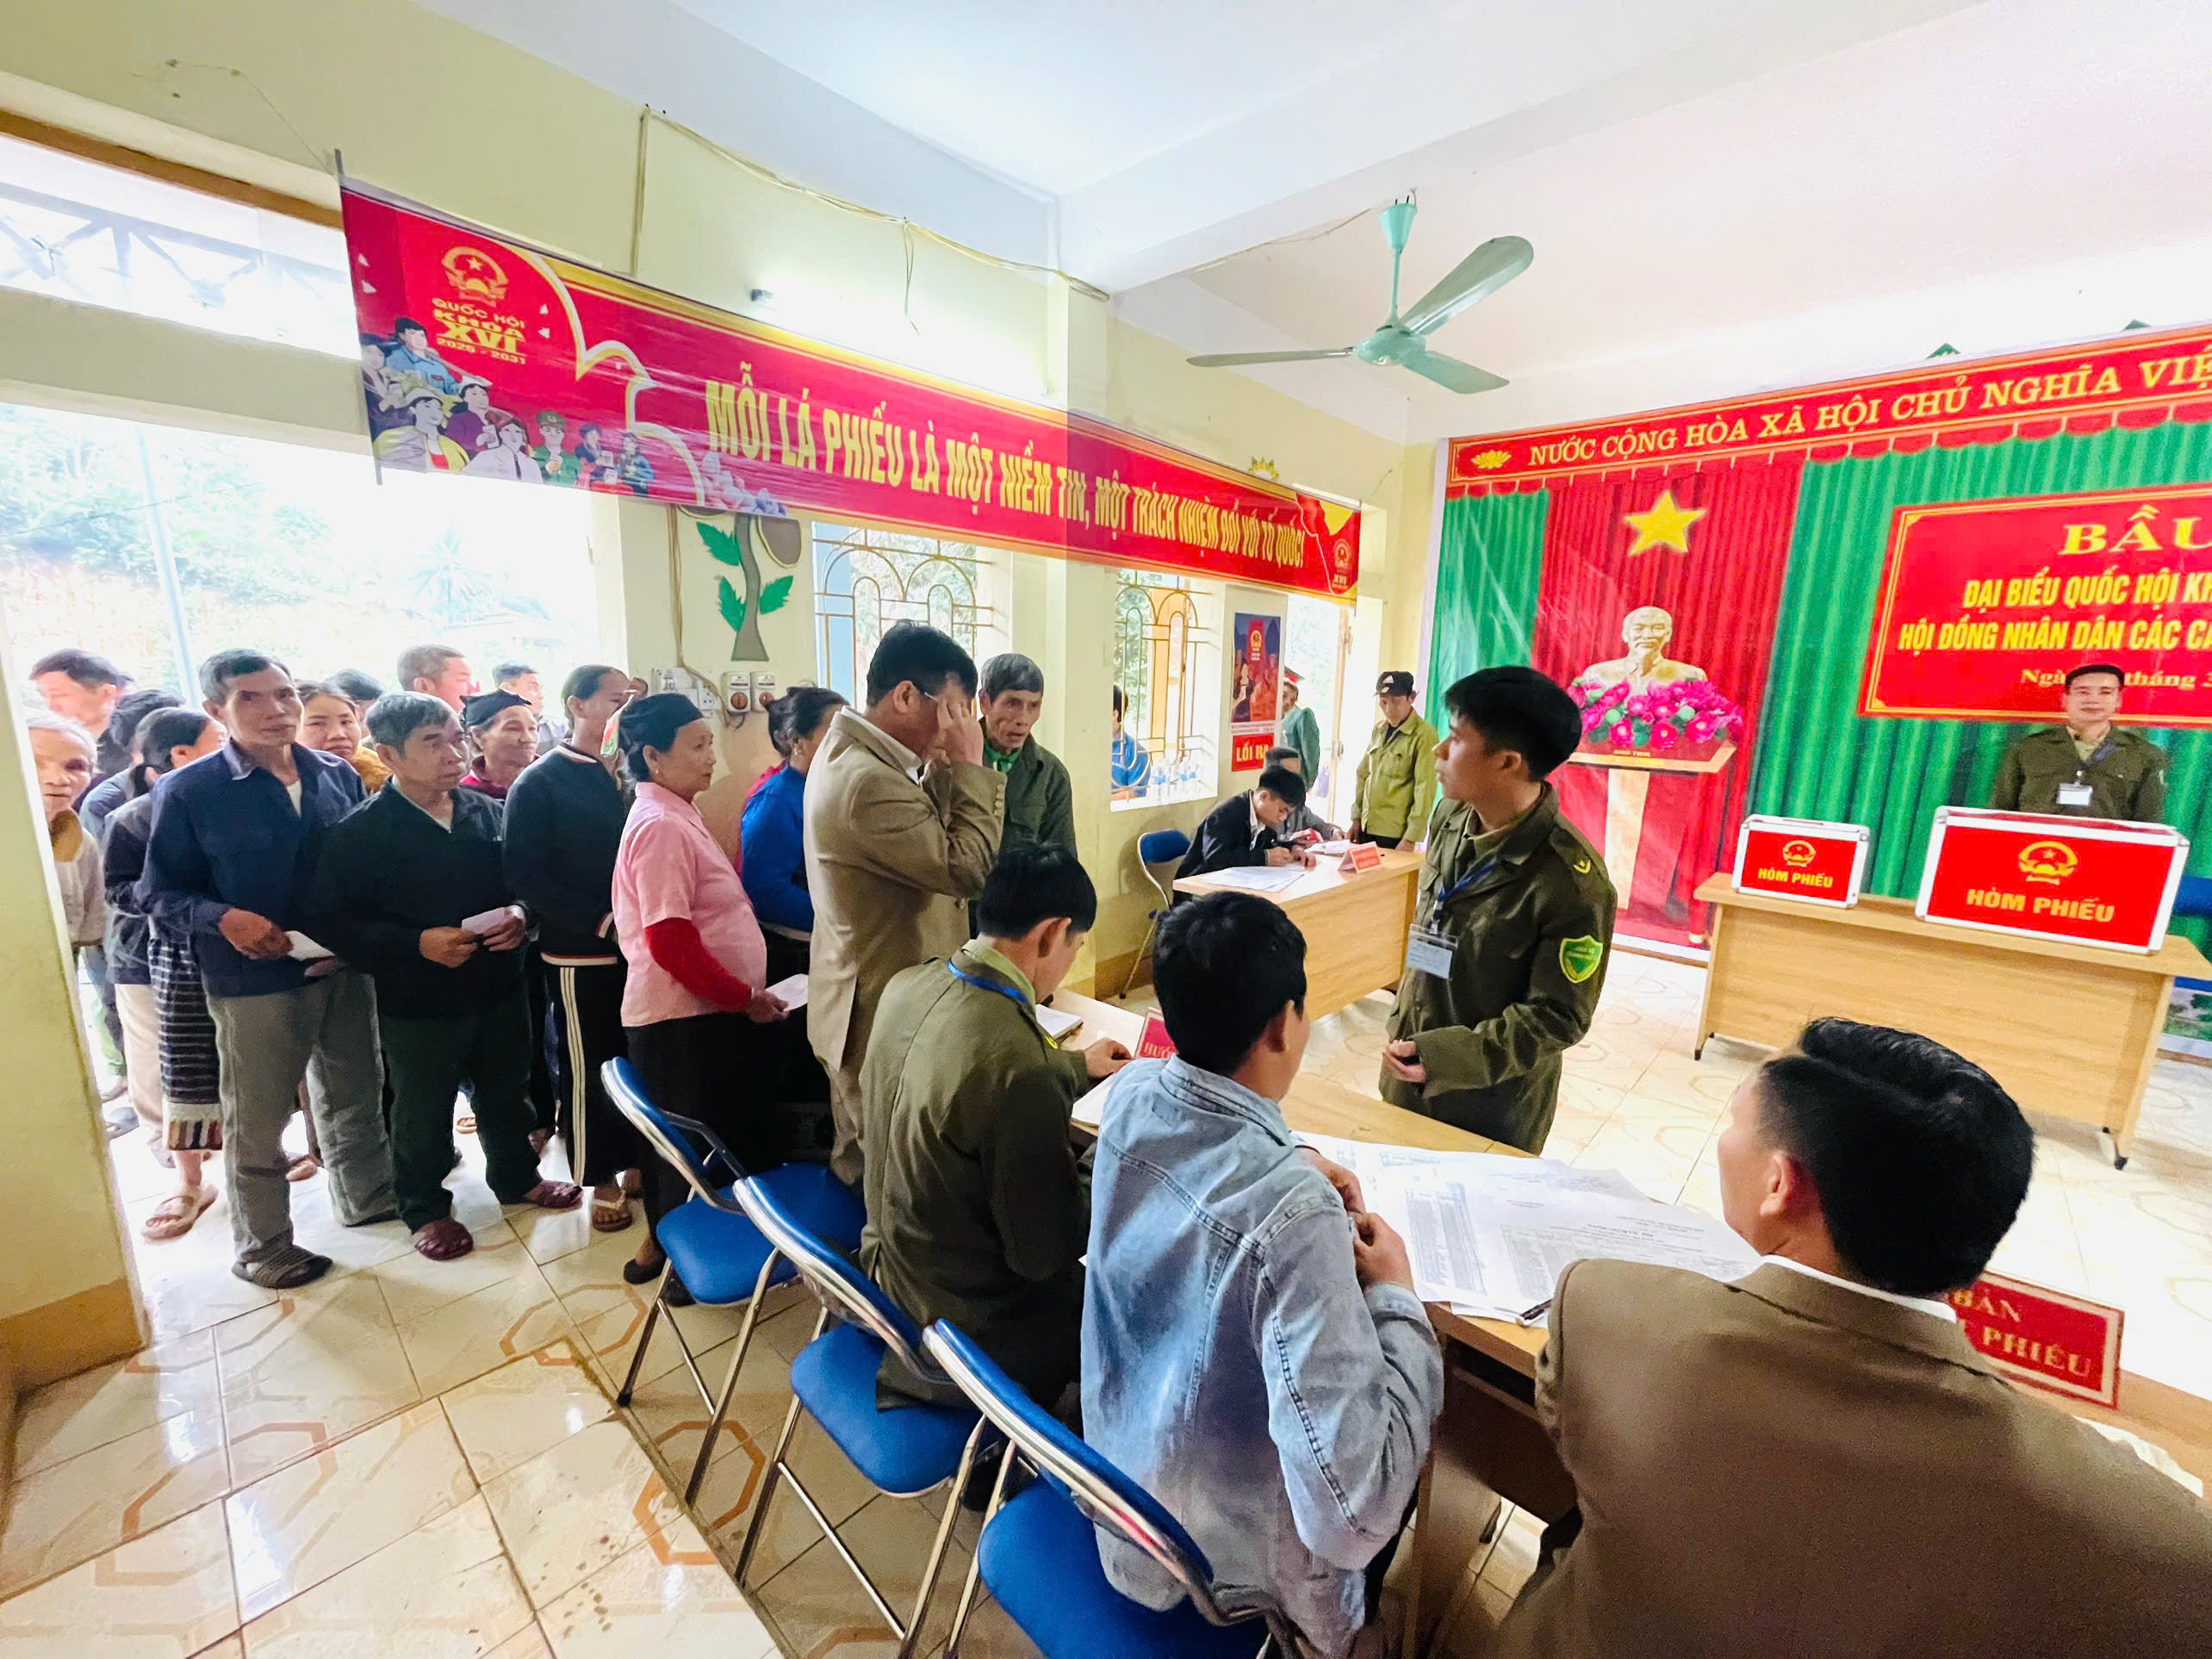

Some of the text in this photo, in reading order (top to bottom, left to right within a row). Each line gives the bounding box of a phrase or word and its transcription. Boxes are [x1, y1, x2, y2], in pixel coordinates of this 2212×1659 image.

[435, 317, 528, 357] XVI
[1528, 435, 1596, 466] NƯỚC
[1602, 427, 1677, 461] CỘNG
[1684, 415, 1748, 447] HÒA
[1759, 406, 1805, 438] XÃ
[1814, 395, 1882, 432] HỘI
[1892, 375, 1972, 419] CHỦ
[1980, 363, 2122, 409] NGHĨA
[705, 361, 771, 463] MỖI
[779, 388, 816, 471] LÁ
[823, 401, 904, 488] PHIẾU
[910, 420, 940, 494] LÀ
[946, 432, 992, 515] MỘT
[999, 439, 1053, 516] NIỀM
[1096, 469, 1131, 541] MỘT
[1132, 482, 1179, 541] TRÁCH
[1178, 496, 1220, 557] NHIỆM
[1963, 579, 2003, 614] ĐẠI
[2005, 565, 2060, 607] BIỂU
[2065, 564, 2130, 609] QUỐC
[2134, 567, 2180, 611] HỘI
[1898, 617, 1936, 657] HỘI
[2003, 615, 2069, 650] NHÂN
[2071, 614, 2125, 650] DÂN
[2128, 613, 2182, 650] CÁC
[2020, 668, 2066, 687] Ngà
[1758, 867, 1834, 889] HÒM PHIẾU
[1966, 886, 2116, 923] HÒM PHIẾU
[1143, 1042, 1171, 1059] HƯỚ
